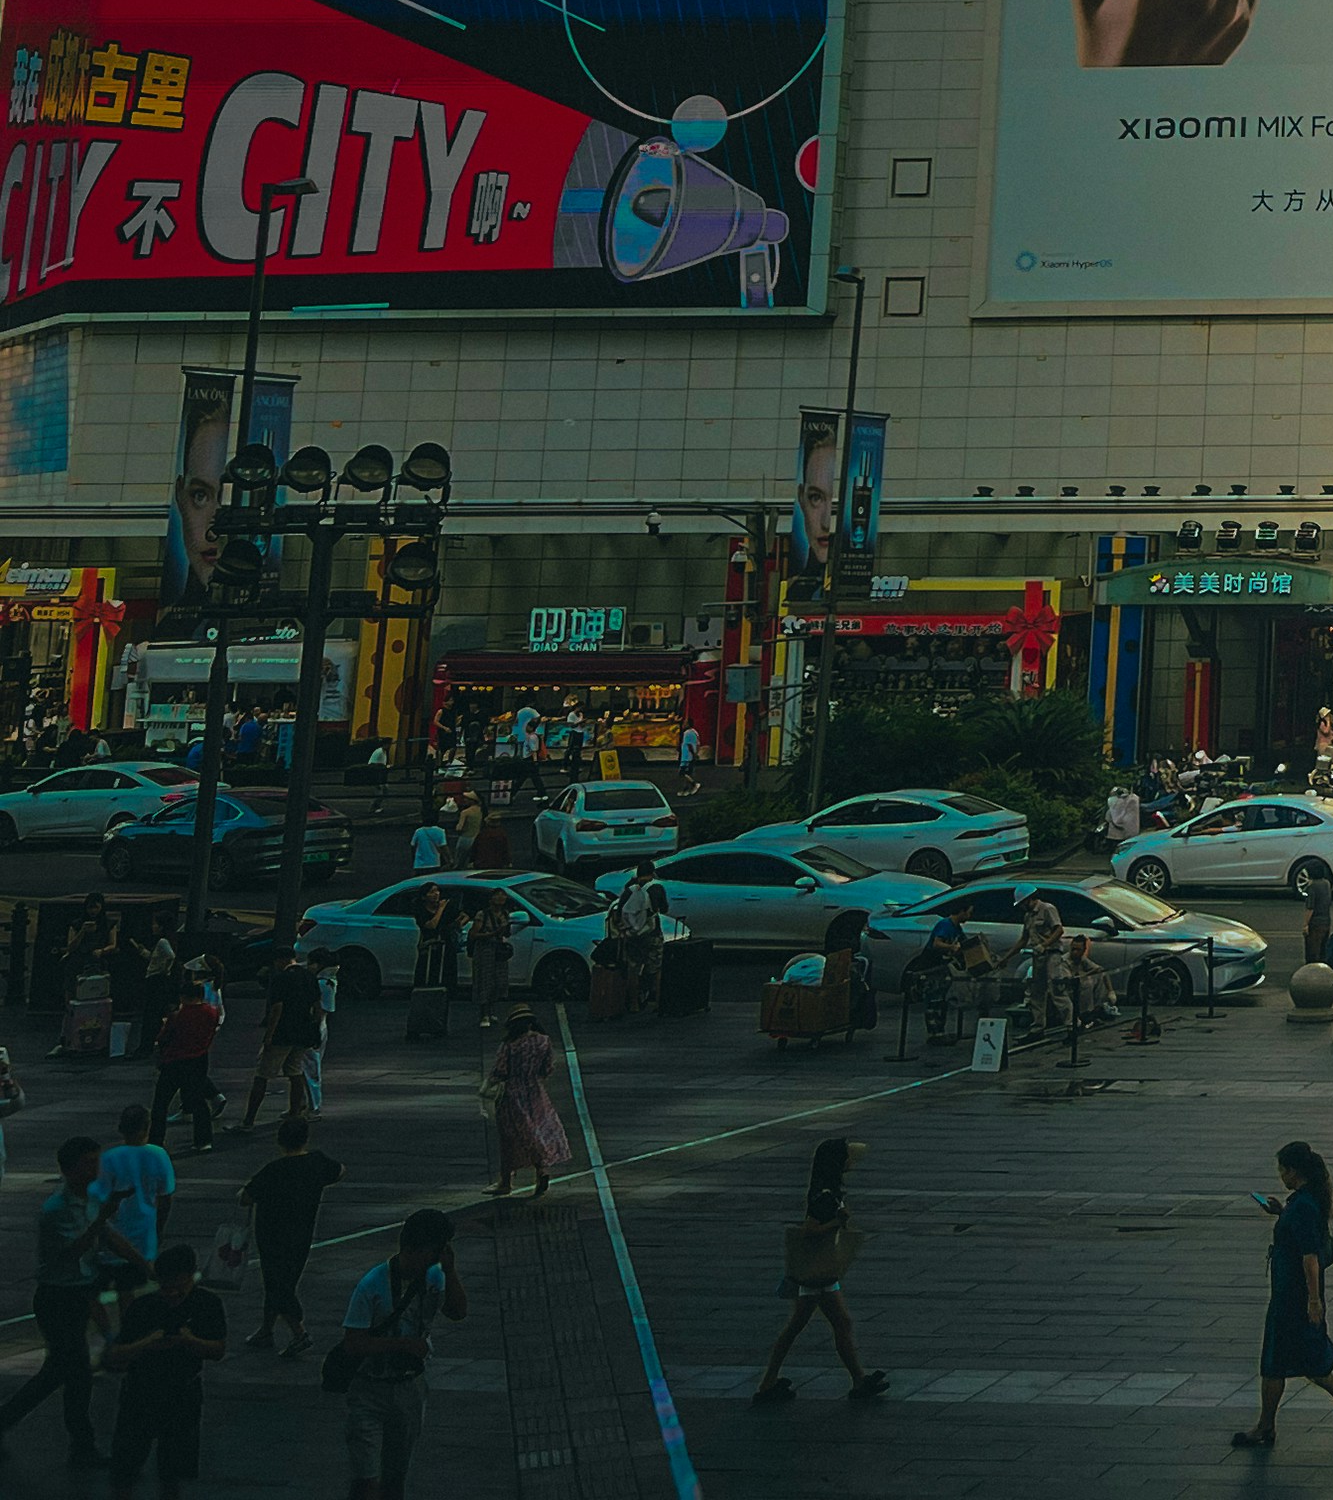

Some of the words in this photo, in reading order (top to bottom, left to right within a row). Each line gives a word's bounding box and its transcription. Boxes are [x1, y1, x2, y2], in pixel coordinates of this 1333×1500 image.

[1119, 114, 1247, 140] xiaomi
[1258, 115, 1303, 139] MIX
[121, 181, 181, 256] 不
[203, 73, 486, 261] CITY
[1172, 571, 1293, 595] 美美时尚馆
[568, 642, 598, 652] CHAN
